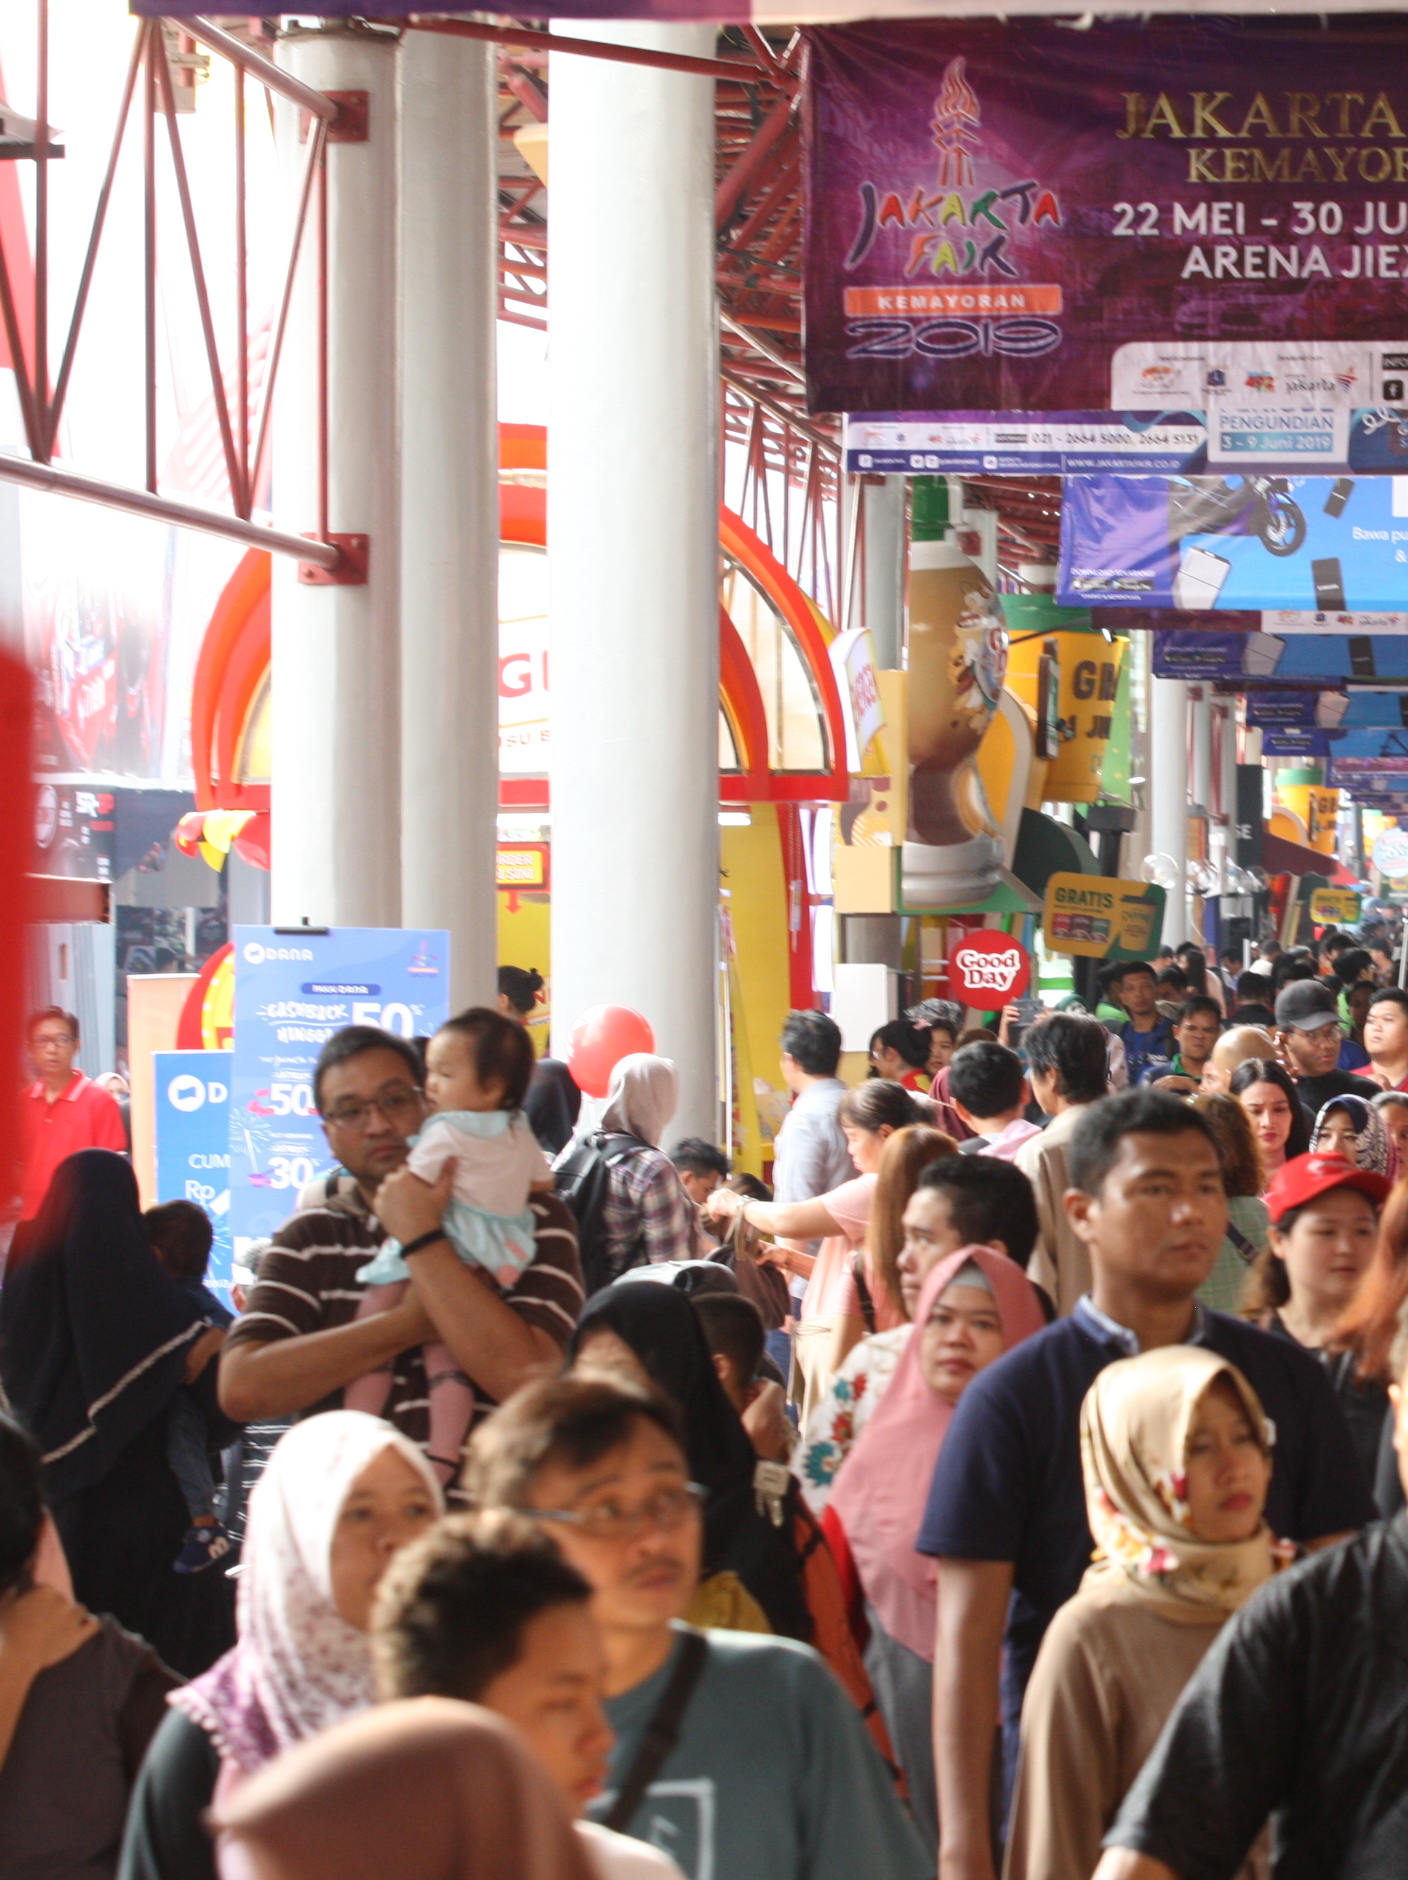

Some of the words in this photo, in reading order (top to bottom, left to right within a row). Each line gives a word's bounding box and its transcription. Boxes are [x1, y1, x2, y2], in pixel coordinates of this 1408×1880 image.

[1115, 92, 1404, 139] JAKARTA
[845, 181, 1062, 271] JAKARTA
[1111, 202, 1161, 236] 22
[1173, 202, 1245, 236] MEI
[1292, 202, 1342, 236] 30
[907, 234, 1018, 278] FAIR
[1180, 246, 1332, 279] ARENA
[877, 294, 1026, 310] KEMAYORAN
[846, 319, 1062, 360] 2019
[1220, 415, 1334, 430] PENGUNDIAN
[1032, 433, 1052, 444] 021
[1065, 433, 1097, 444] 2664
[1173, 433, 1200, 445] 5131
[1222, 436, 1232, 449] 3
[1247, 436, 1255, 449] 9
[1259, 435, 1293, 451] Juni
[1299, 435, 1331, 449] 2019
[1352, 527, 1389, 541] Bawa
[1395, 551, 1407, 563] &
[1055, 887, 1114, 909] GRATIS
[266, 948, 313, 961] DANA
[960, 951, 1018, 970] Good
[969, 969, 1012, 990] Day
[267, 1001, 349, 1020] CASHBACK
